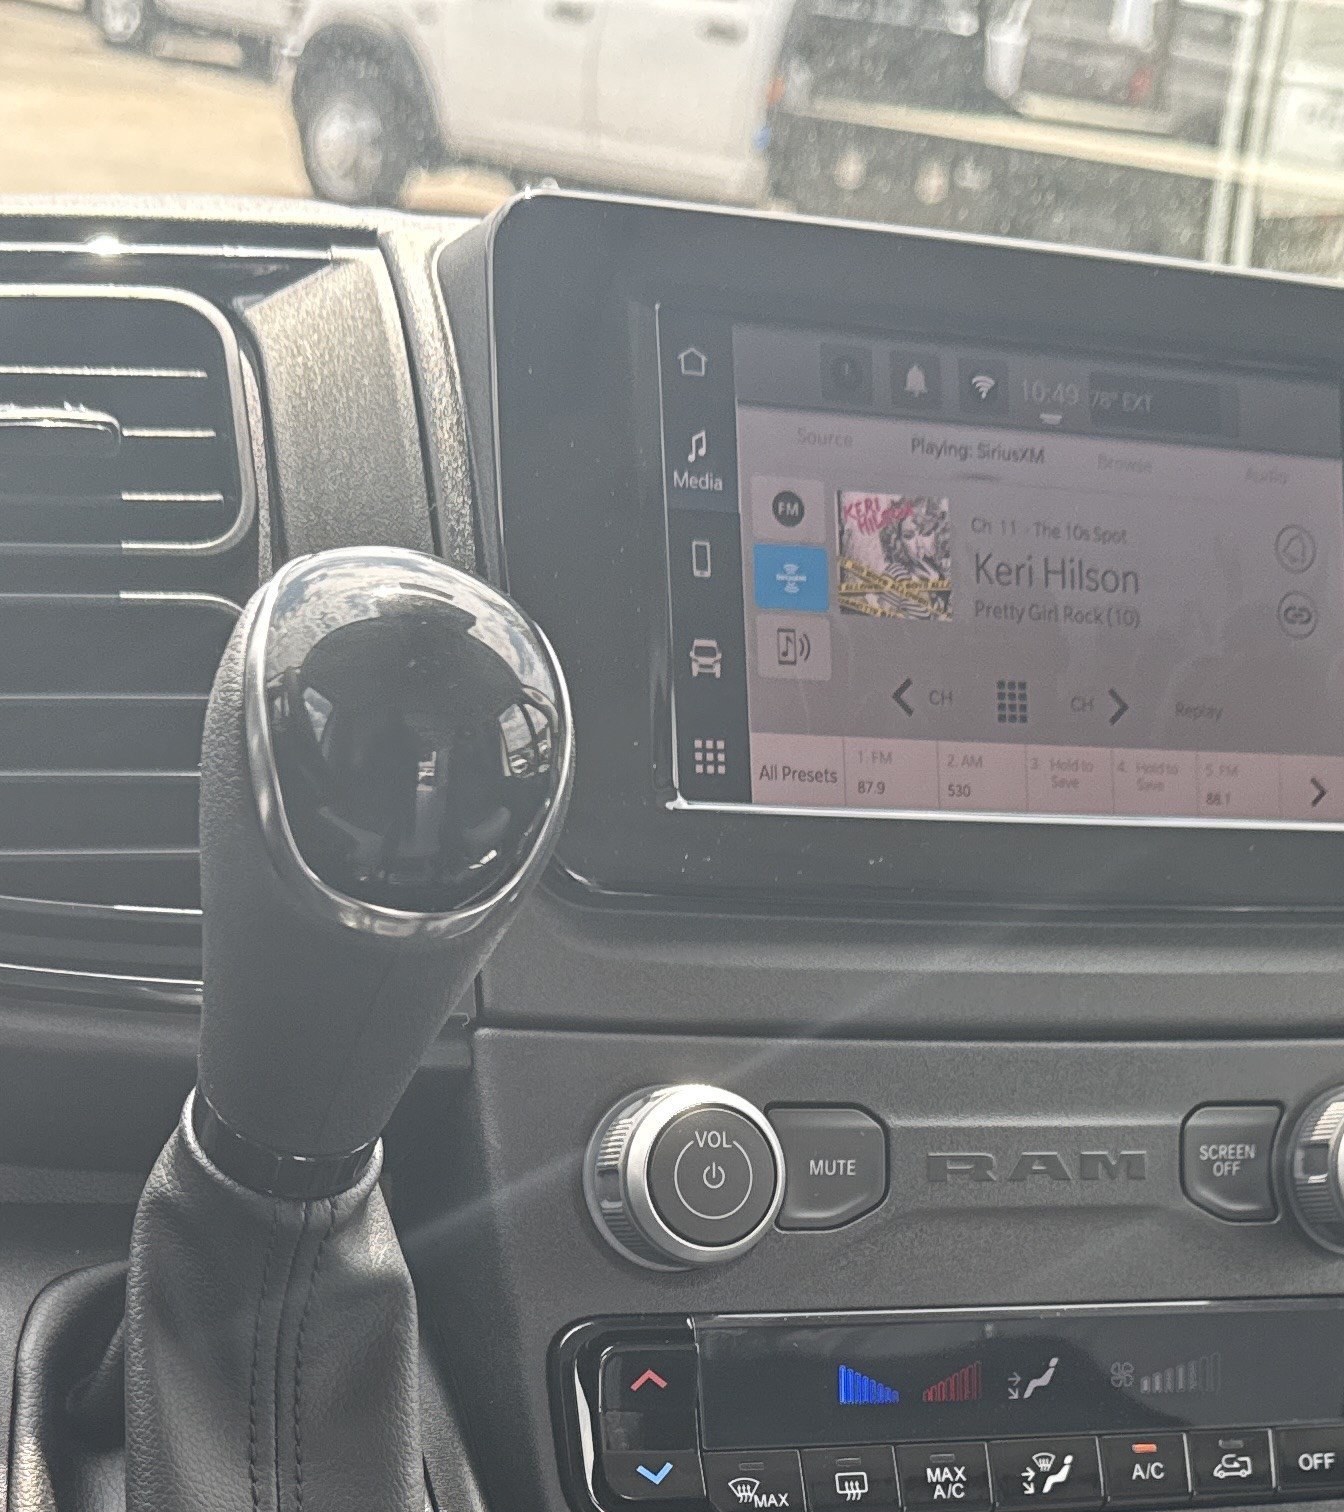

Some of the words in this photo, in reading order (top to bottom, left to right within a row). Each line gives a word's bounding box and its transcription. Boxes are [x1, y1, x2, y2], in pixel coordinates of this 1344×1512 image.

[796, 427, 854, 447] Source
[911, 435, 973, 462] Playing:
[976, 441, 1046, 465] SiriusXM
[673, 471, 723, 491] Media
[778, 502, 799, 516] FM
[971, 517, 992, 534] Ch
[1033, 521, 1061, 539] The
[1093, 525, 1127, 545] Spot
[974, 552, 1033, 589] Keri
[1043, 556, 1139, 595] Hilson
[975, 600, 1025, 625] Pretty
[1028, 603, 1058, 623] Girl
[1063, 605, 1104, 625] Rock
[1107, 606, 1141, 628] (10)
[929, 689, 953, 706] CH
[1070, 695, 1095, 713] CH
[960, 754, 984, 768] AM
[759, 764, 778, 781] All
[782, 766, 838, 784] Presets
[857, 780, 886, 796] 87.9
[948, 783, 971, 798] 530
[695, 1131, 732, 1149] VOL
[1199, 1144, 1256, 1160] SCREEN
[809, 1159, 856, 1176] MUTE
[927, 1151, 1147, 1183] RAM
[1212, 1161, 1241, 1177] OFF
[1298, 1452, 1335, 1471] OFF
[926, 1466, 966, 1484] MAX
[1132, 1461, 1165, 1481] A/C
[933, 1483, 965, 1499] A/C
[754, 1493, 789, 1508] MAX
